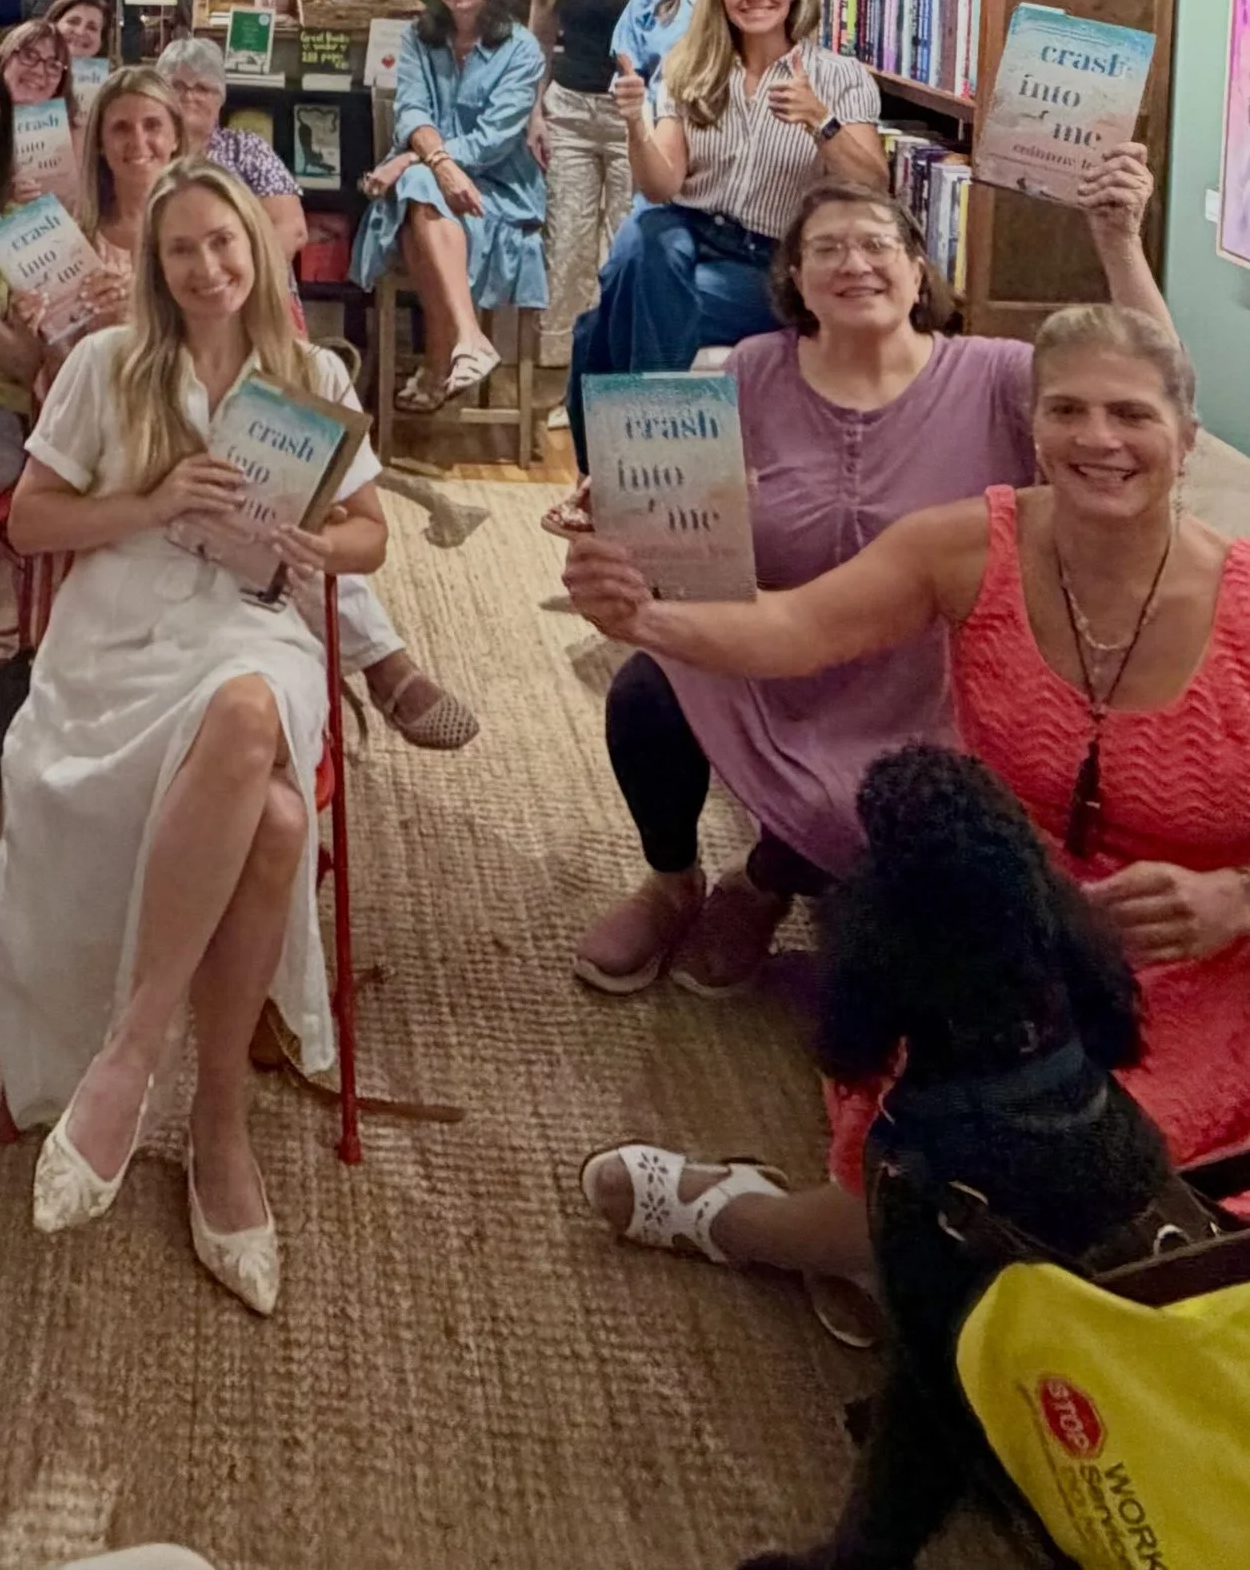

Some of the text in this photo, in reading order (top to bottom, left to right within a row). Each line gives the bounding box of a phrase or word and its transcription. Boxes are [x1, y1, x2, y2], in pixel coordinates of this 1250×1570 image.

[77, 71, 101, 85] ash
[1040, 44, 1131, 78] crash
[1018, 73, 1081, 108] into
[1052, 122, 1103, 151] me
[10, 213, 63, 252] crash
[17, 249, 58, 279] into
[625, 408, 720, 440] crash
[248, 419, 316, 464] crash
[616, 458, 685, 492] into
[667, 507, 721, 532] me
[1046, 1378, 1091, 1452] STOP
